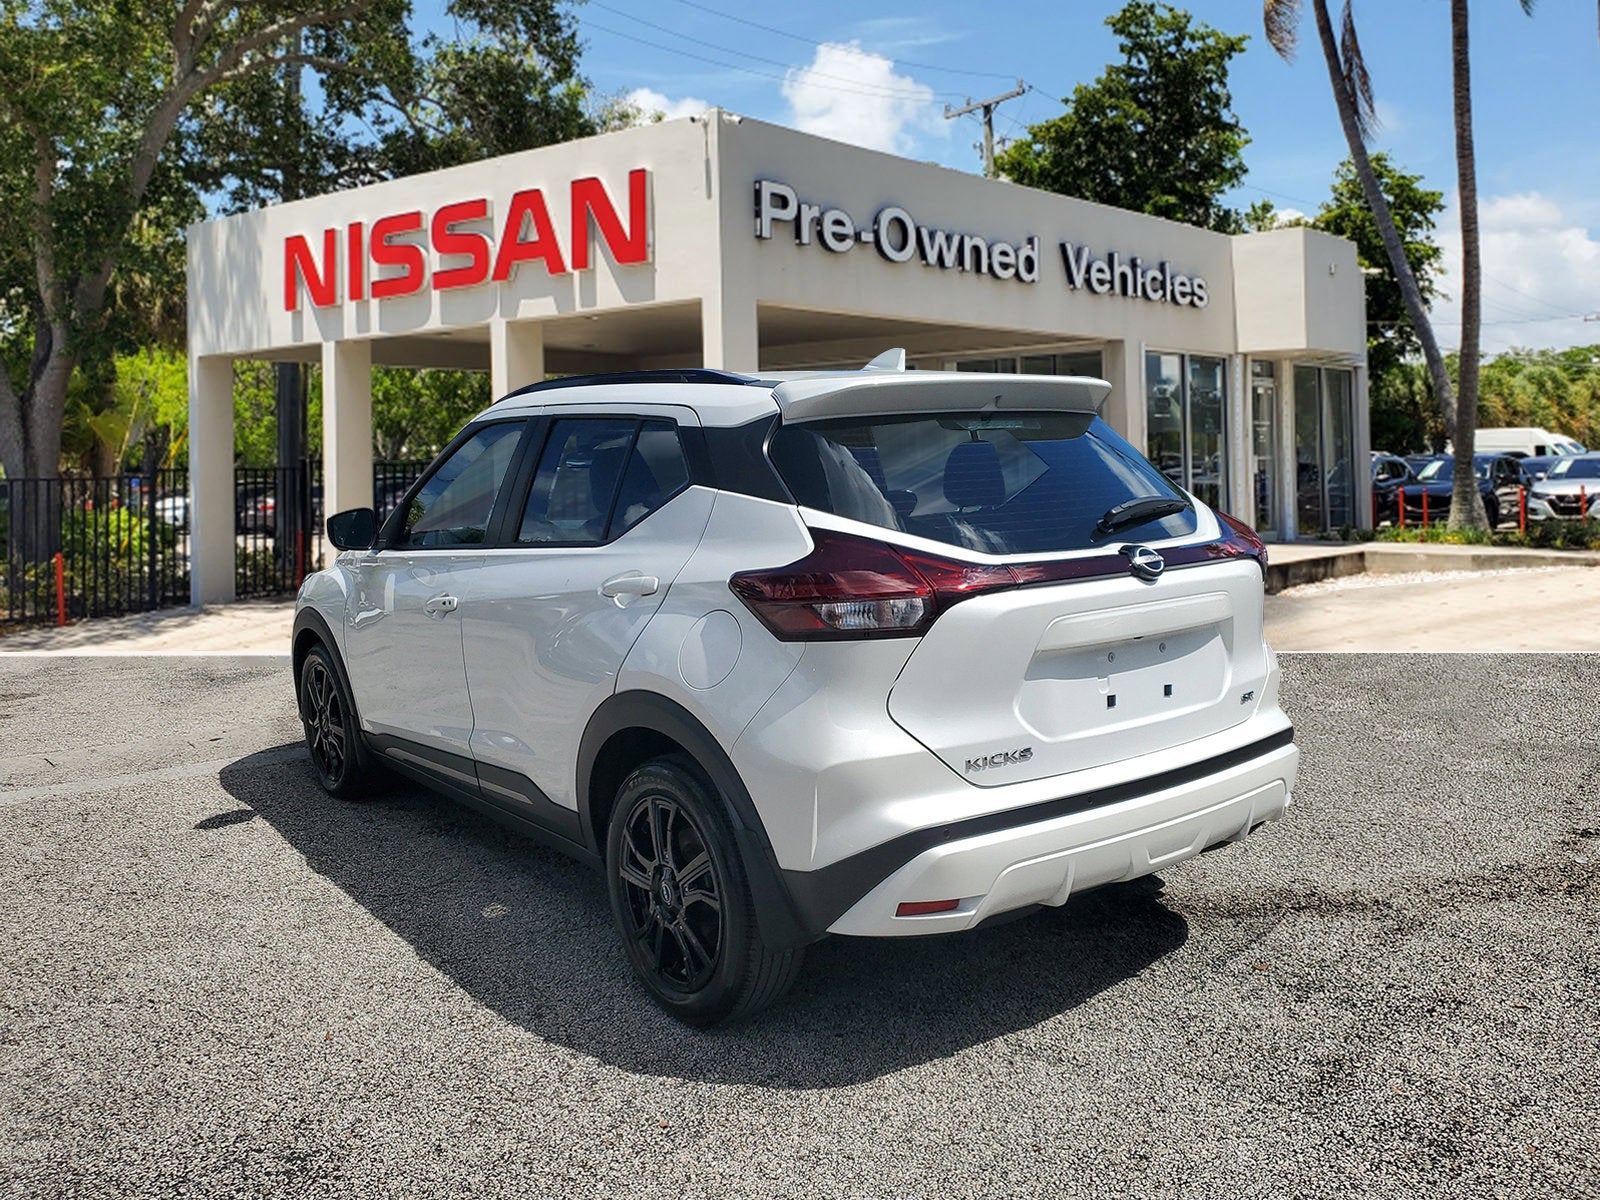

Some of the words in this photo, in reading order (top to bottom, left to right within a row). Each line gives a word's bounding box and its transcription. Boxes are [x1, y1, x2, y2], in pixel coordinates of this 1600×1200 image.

[284, 168, 648, 313] NISSAN
[754, 179, 1040, 284] Pre-Owned
[1059, 242, 1209, 309] Vehicles
[964, 747, 1034, 774] KICKS
